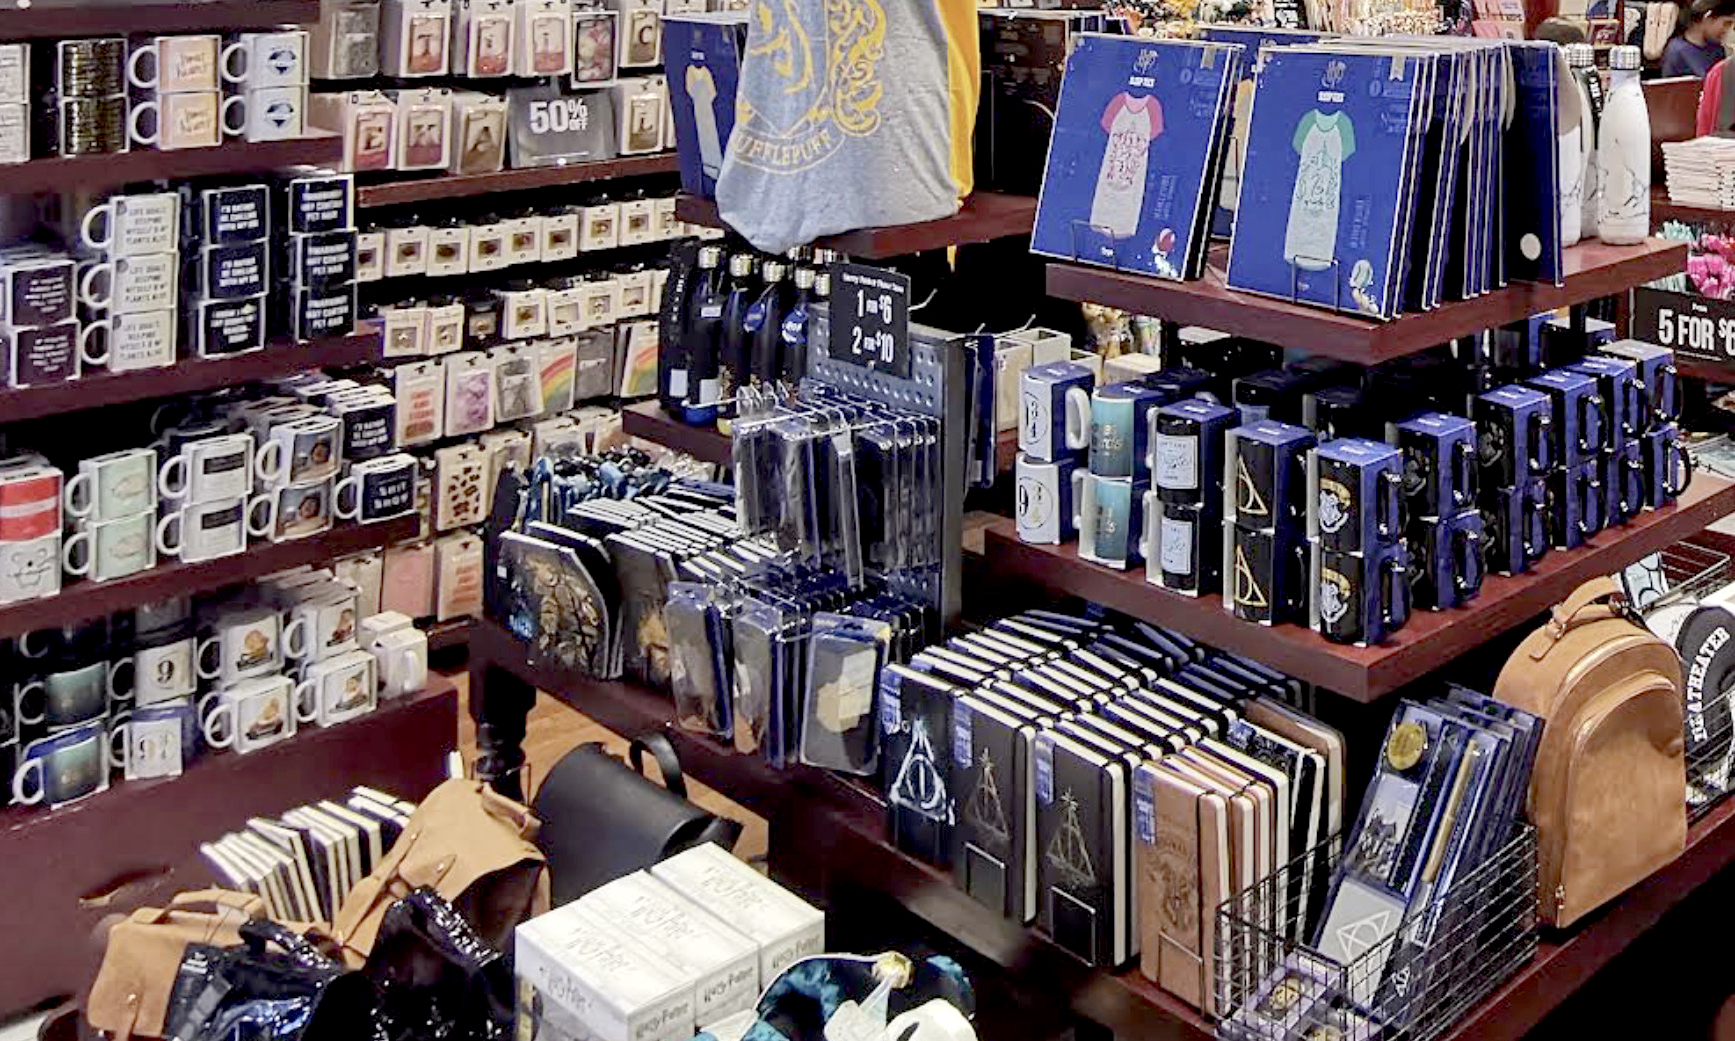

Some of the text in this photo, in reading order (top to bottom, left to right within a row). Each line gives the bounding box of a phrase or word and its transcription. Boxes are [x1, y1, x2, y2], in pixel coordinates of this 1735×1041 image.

[530, 98, 588, 134] 50%
[857, 289, 865, 317] 1
[879, 294, 893, 325] $6
[851, 325, 863, 355] 2
[875, 330, 894, 363] $10
[1658, 309, 1674, 345] 5
[1677, 313, 1715, 351] FOR
